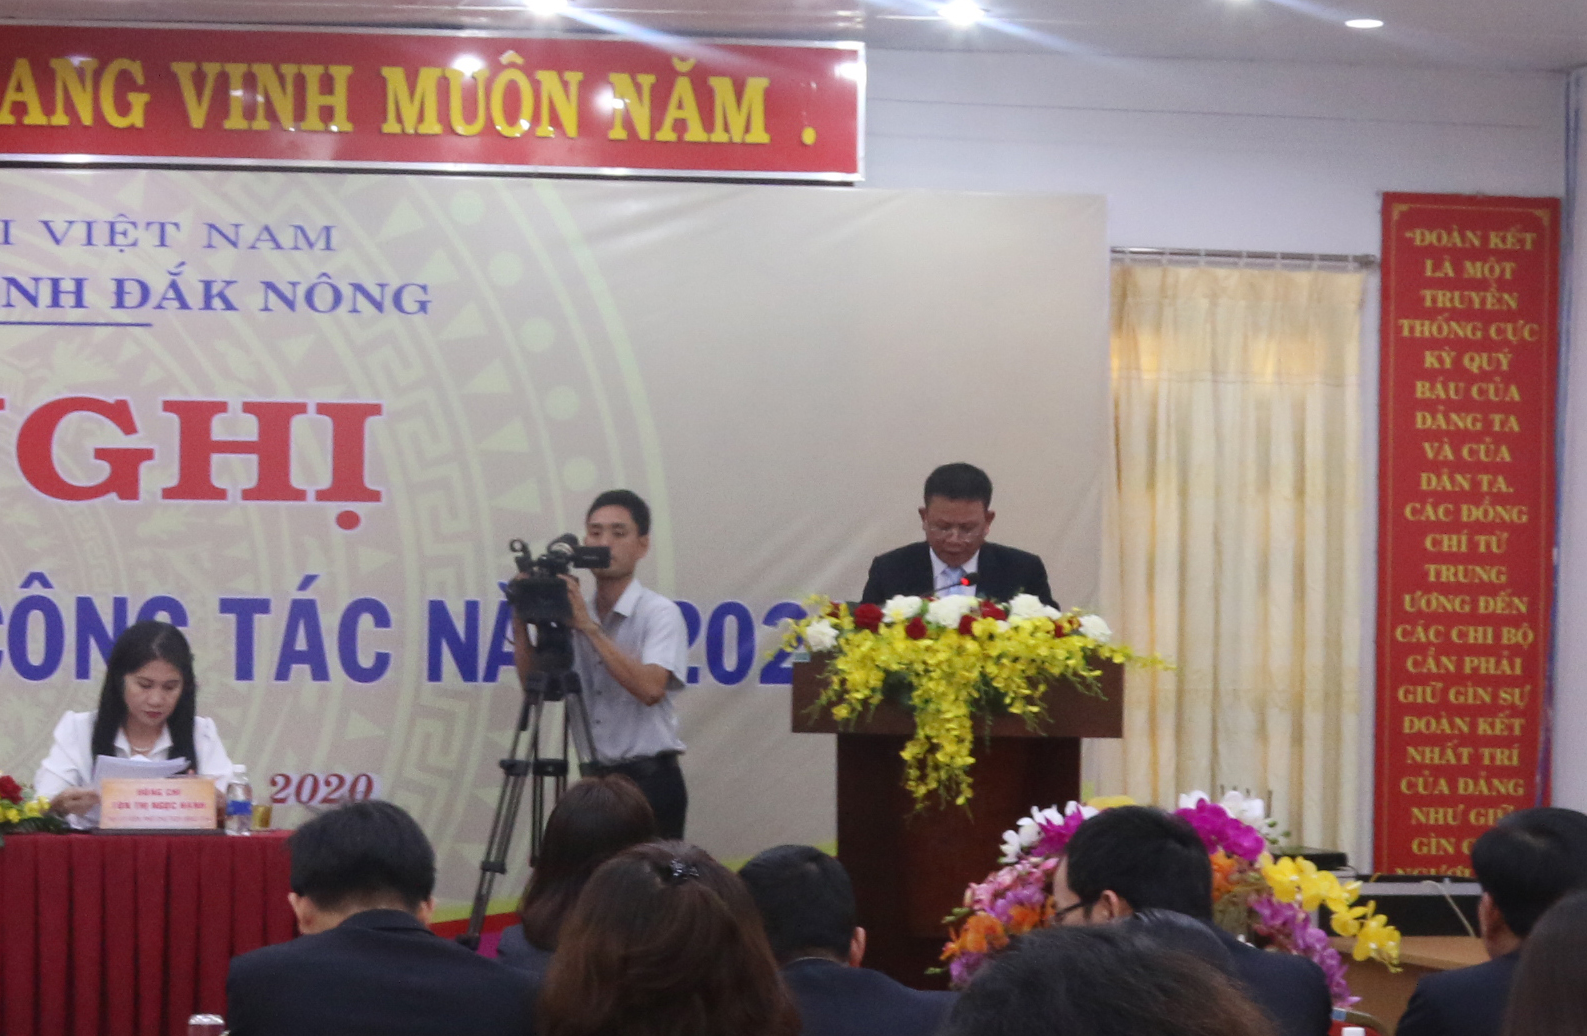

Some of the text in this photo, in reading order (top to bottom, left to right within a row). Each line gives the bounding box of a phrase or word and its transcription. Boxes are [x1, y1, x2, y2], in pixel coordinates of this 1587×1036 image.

[170, 61, 354, 132] VINH
[381, 50, 584, 138] MUÔN
[607, 56, 771, 143] NĂM
[38, 213, 181, 253] VIỆT
[202, 222, 337, 252] NAM
[111, 261, 240, 313] ĐẮK
[259, 273, 433, 316] NÔNG
[1489, 413, 1521, 432] TA
[1425, 565, 1507, 584] TRUNG
[218, 574, 392, 683] TÁC
[1451, 625, 1493, 644] CHI
[269, 774, 373, 803] 2020
